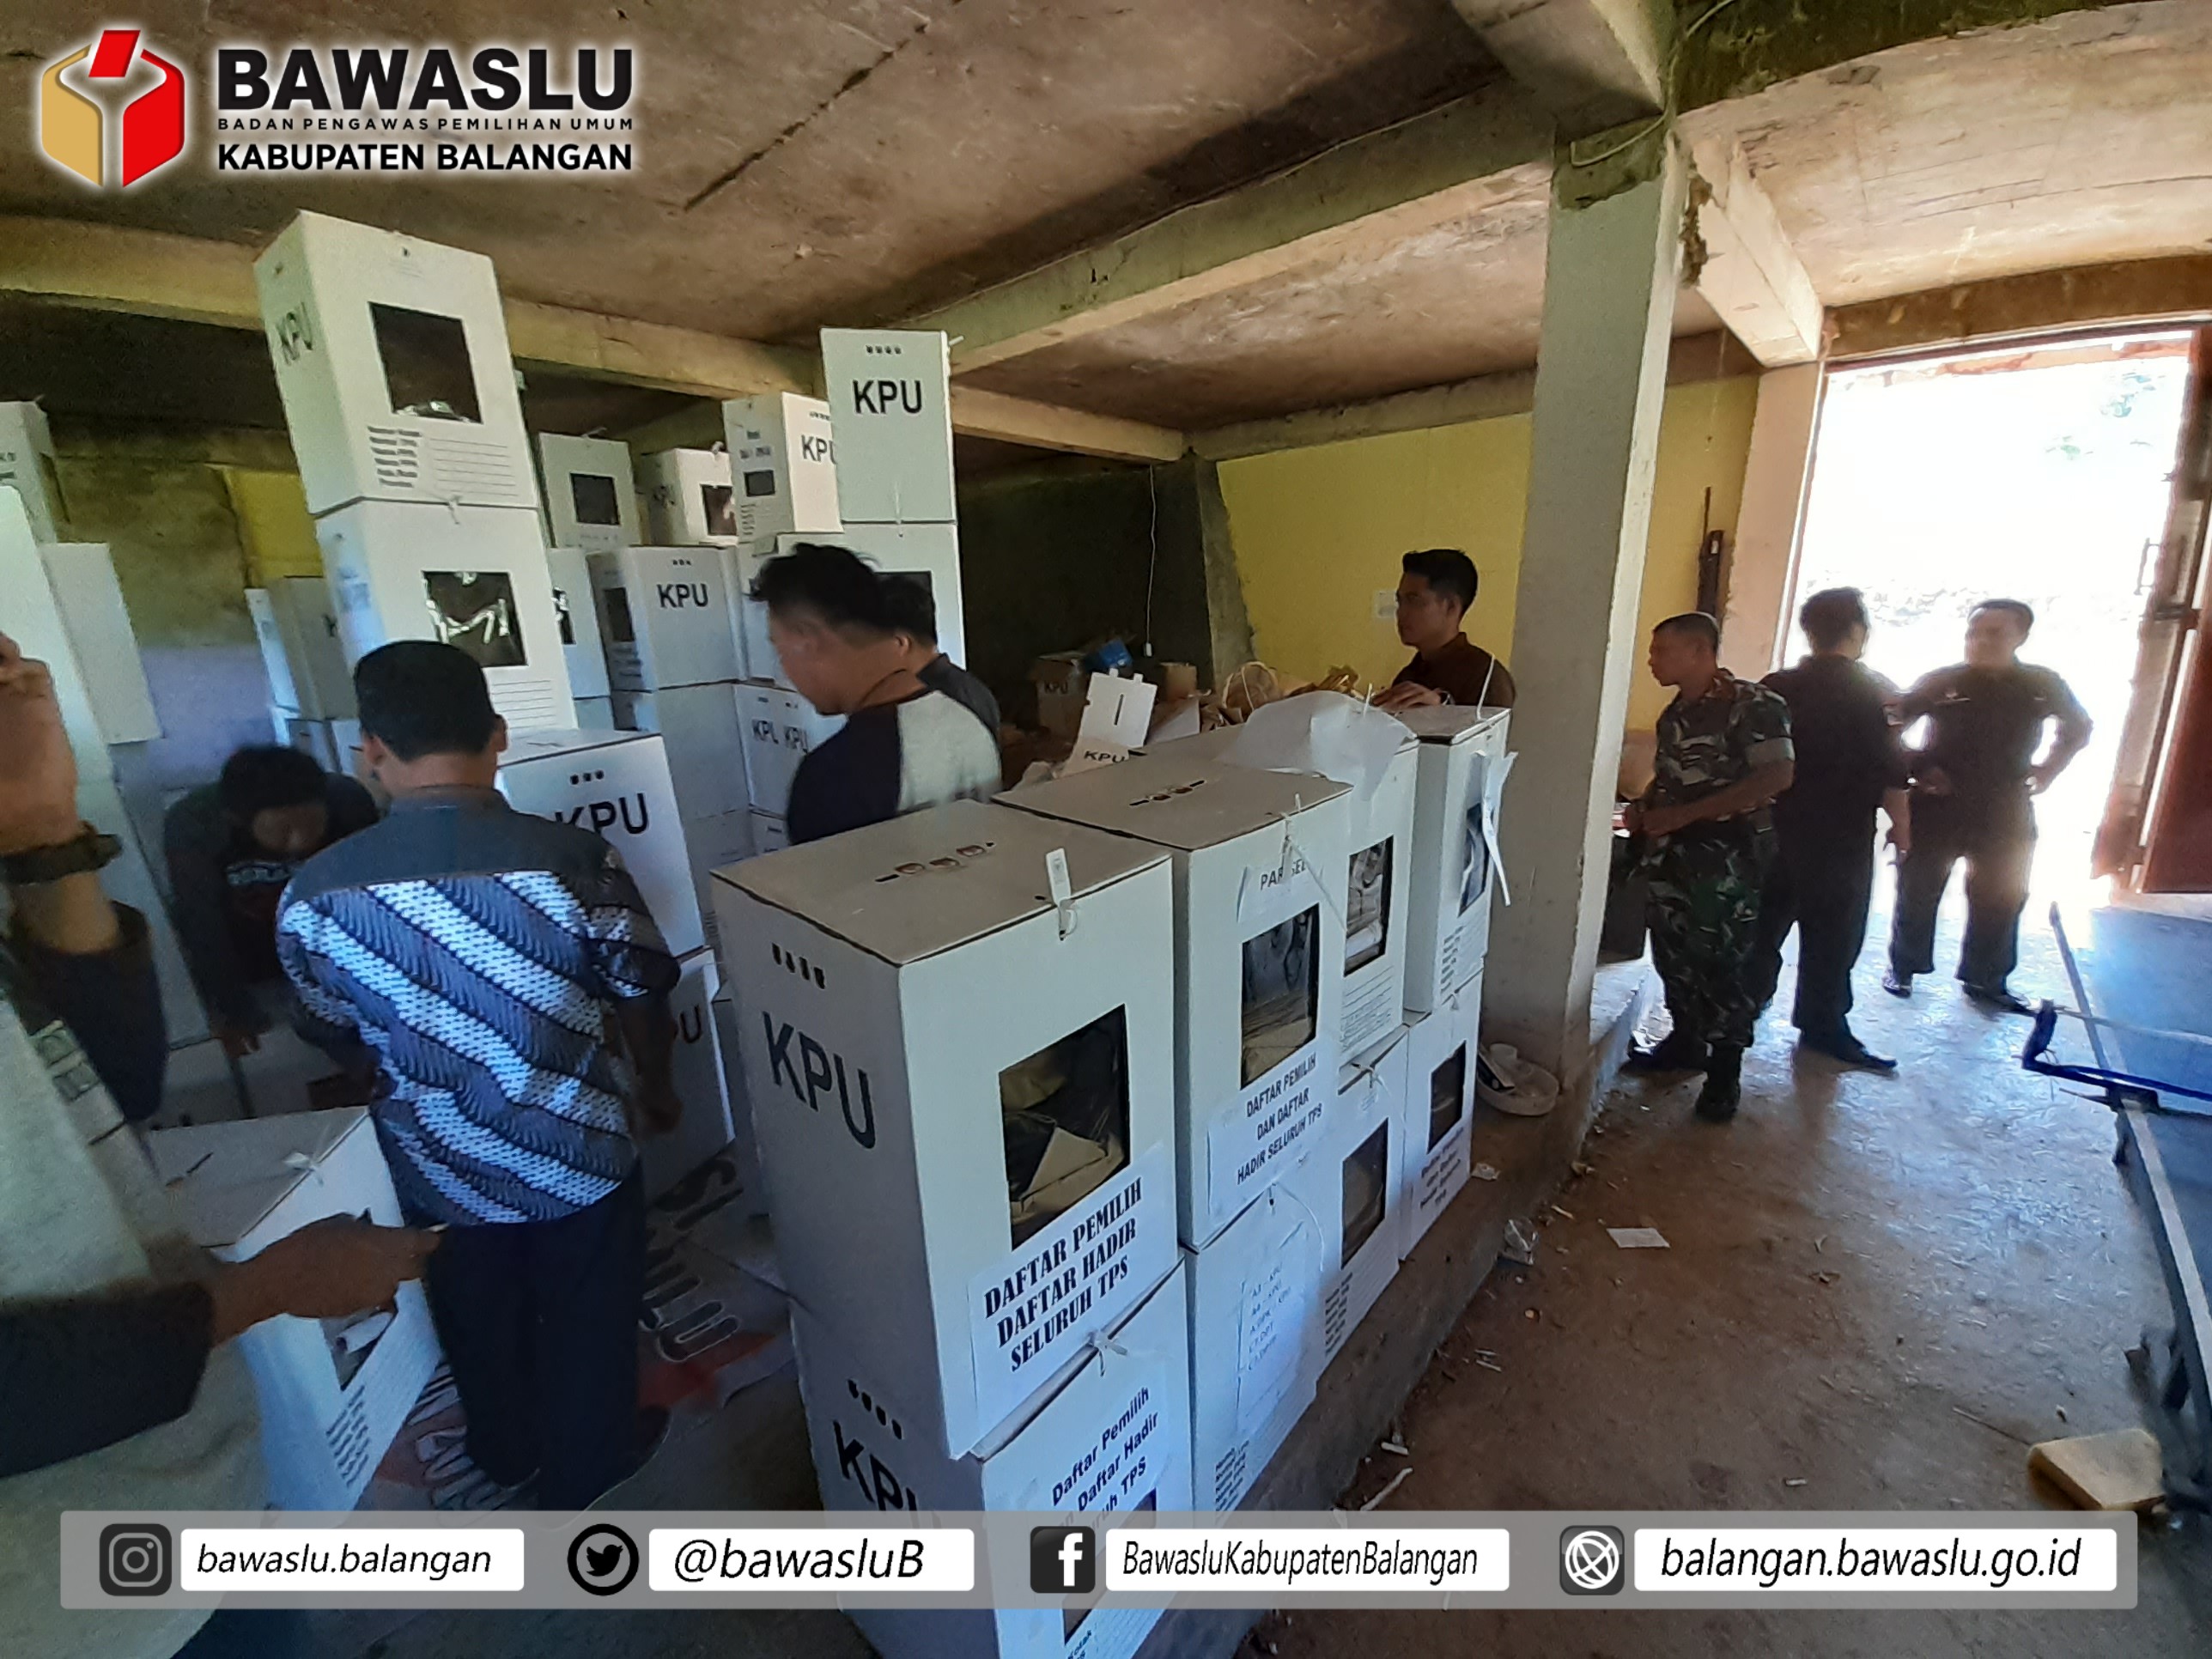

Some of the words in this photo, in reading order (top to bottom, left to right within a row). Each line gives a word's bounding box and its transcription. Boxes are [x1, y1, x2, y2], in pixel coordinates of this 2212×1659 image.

[852, 379, 923, 415] KPU
[656, 583, 709, 609] KPU
[1084, 750, 1125, 763] KPU
[763, 1011, 876, 1149] KPU
[1247, 1079, 1282, 1117] DAFTAR
[1257, 1113, 1276, 1140] DAN
[1278, 1087, 1310, 1125] DAFTAR
[1237, 1149, 1266, 1185] HADIR
[984, 1237, 1067, 1319] DAFTAR
[1073, 1176, 1142, 1254] PEMILIH
[997, 1267, 1078, 1348] DAFTAR
[1082, 1218, 1136, 1280] HADIR
[1011, 1286, 1092, 1372] SELURUH
[1097, 1255, 1128, 1298] TPS
[1052, 1445, 1098, 1507] Daftar
[1102, 1387, 1149, 1451] Pemilih
[1078, 1455, 1121, 1513] Daftar
[1124, 1412, 1158, 1461] Hadir
[1121, 1455, 1146, 1495] TPS
